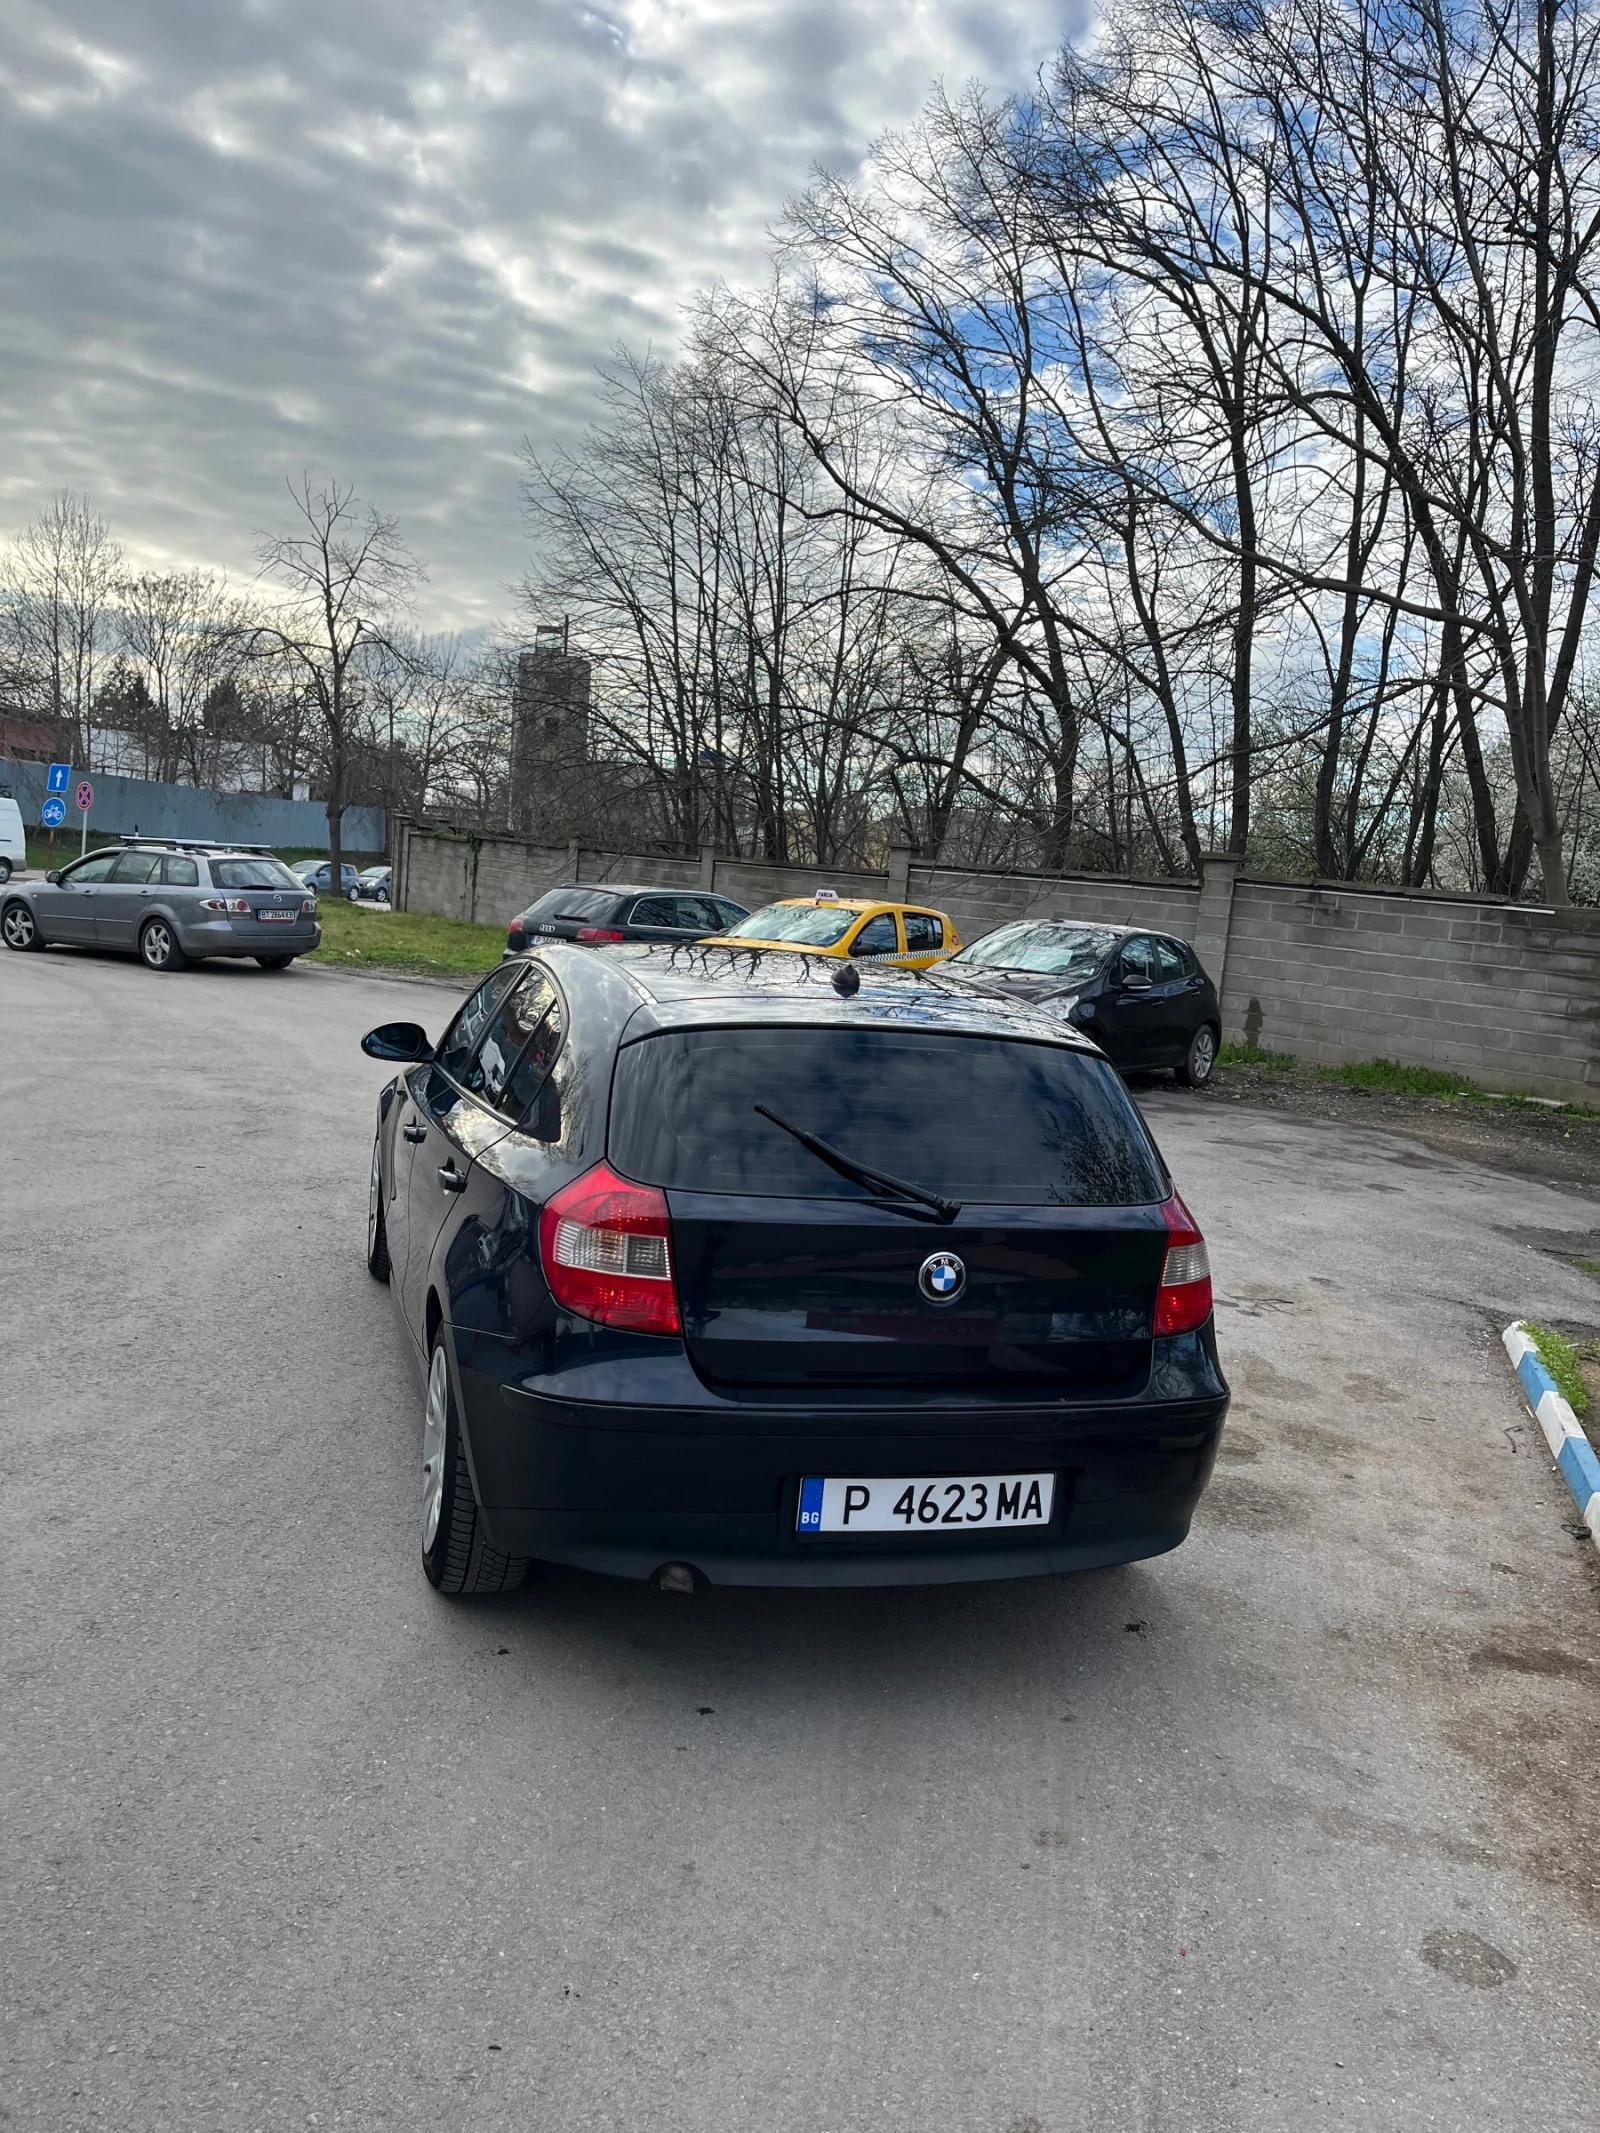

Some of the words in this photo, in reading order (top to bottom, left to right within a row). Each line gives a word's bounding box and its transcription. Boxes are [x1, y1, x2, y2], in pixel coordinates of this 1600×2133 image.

[928, 1257, 962, 1272] BMW
[843, 1485, 870, 1525] P
[801, 1511, 819, 1525] BG
